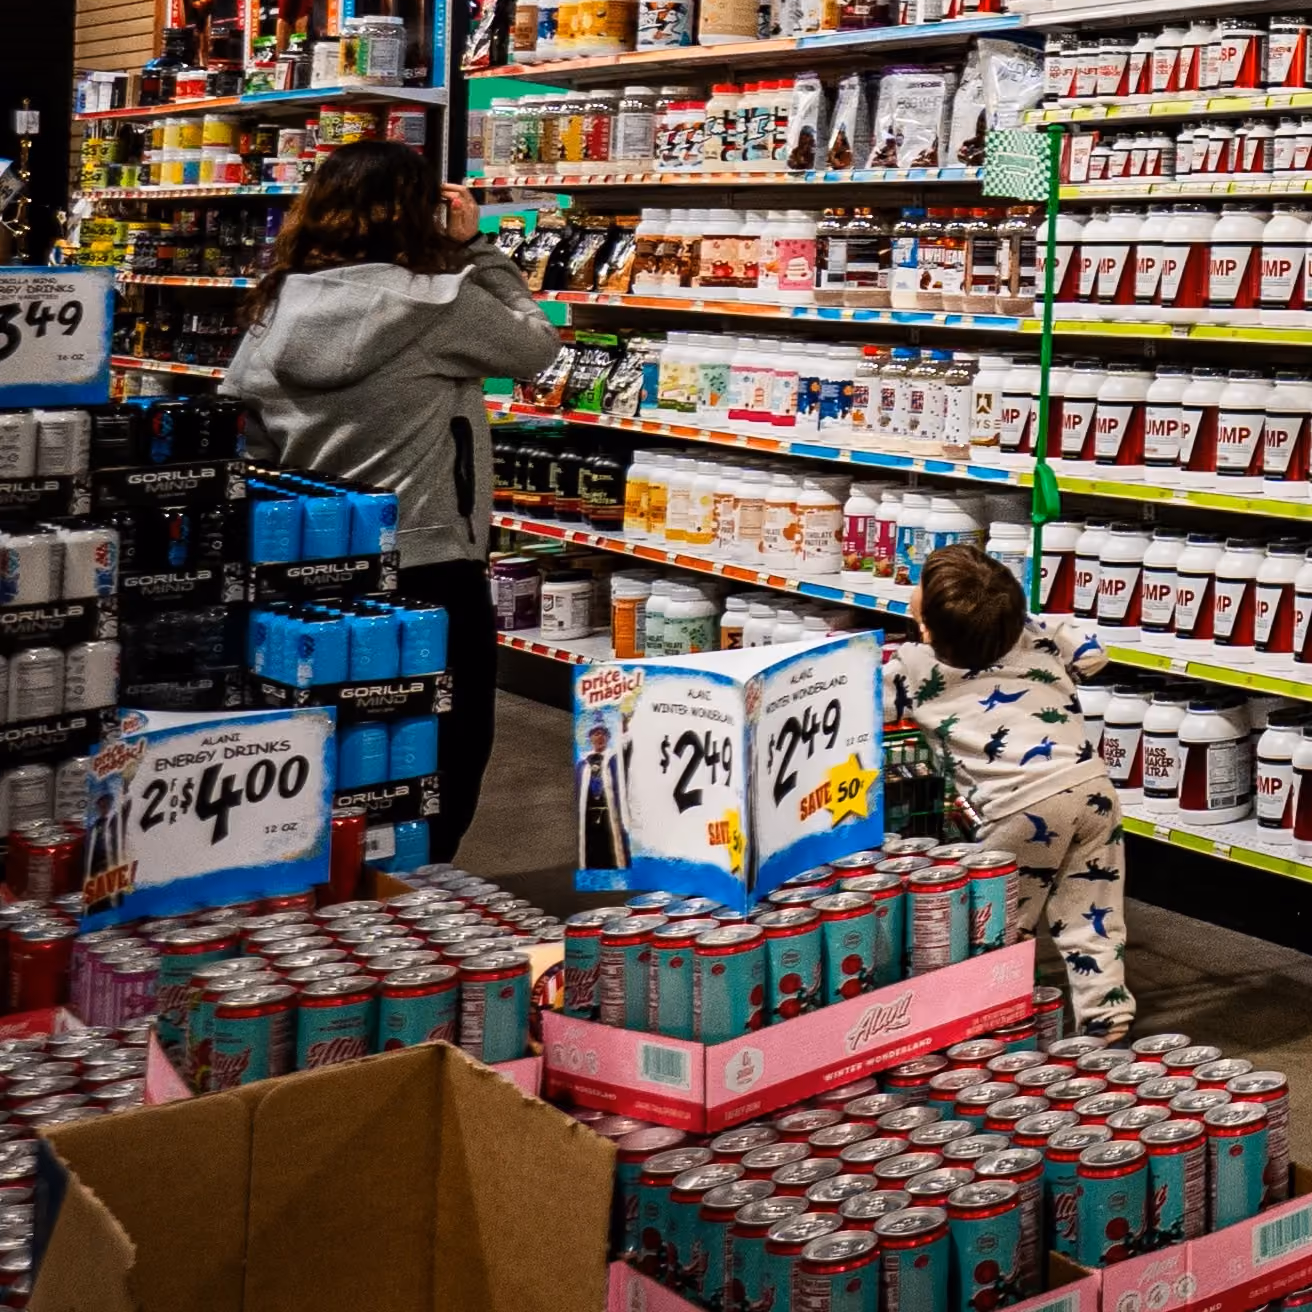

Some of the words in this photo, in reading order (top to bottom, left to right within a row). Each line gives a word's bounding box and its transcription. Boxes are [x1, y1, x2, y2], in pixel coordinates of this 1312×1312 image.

[26, 284, 76, 294] DRINKS
[128, 467, 216, 484] GORILLA
[287, 560, 370, 577] GORILLA
[124, 570, 212, 588] GORILLA
[303, 572, 353, 585] MIND
[1, 605, 84, 624] ORILLA
[339, 682, 424, 700] GORILLA
[581, 669, 620, 696] price
[589, 672, 642, 705] magic!
[792, 675, 848, 701] WONDERLAND
[356, 694, 408, 708] MIND
[201, 732, 241, 746] ALANI
[155, 750, 217, 773] ENERGY
[224, 739, 292, 760] DRINKS
[139, 778, 168, 833] 2
[336, 786, 410, 807] ORILLA
[800, 780, 832, 822] SAVE
[281, 822, 298, 833] OZ
[823, 1061, 863, 1082] WINTER
[865, 1037, 932, 1067] WONDERLAND
